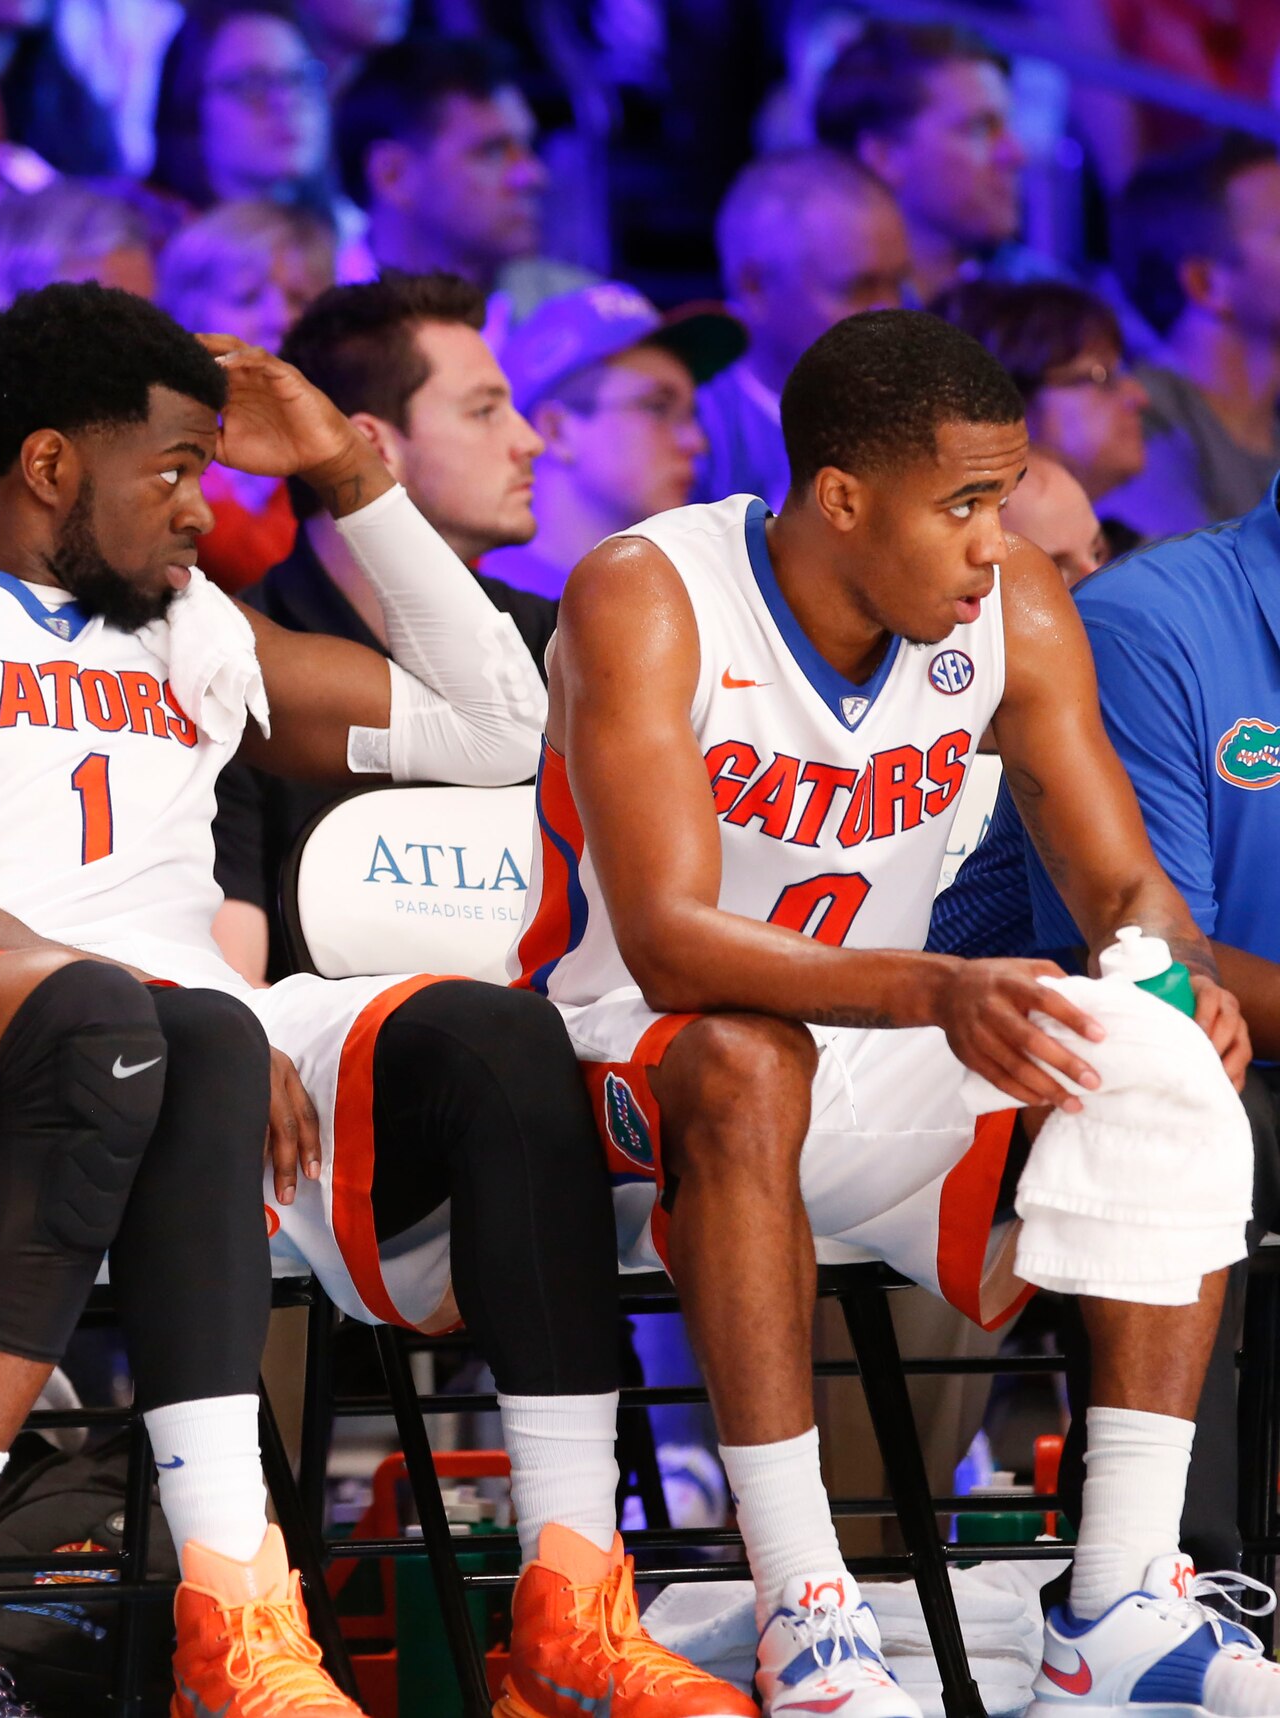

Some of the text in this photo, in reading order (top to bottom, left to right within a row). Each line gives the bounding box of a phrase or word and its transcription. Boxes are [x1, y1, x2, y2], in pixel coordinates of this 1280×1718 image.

[931, 651, 973, 693] SEC
[71, 752, 113, 865] 1
[704, 729, 972, 848] GATORS
[395, 899, 524, 922] PARADISE ISL
